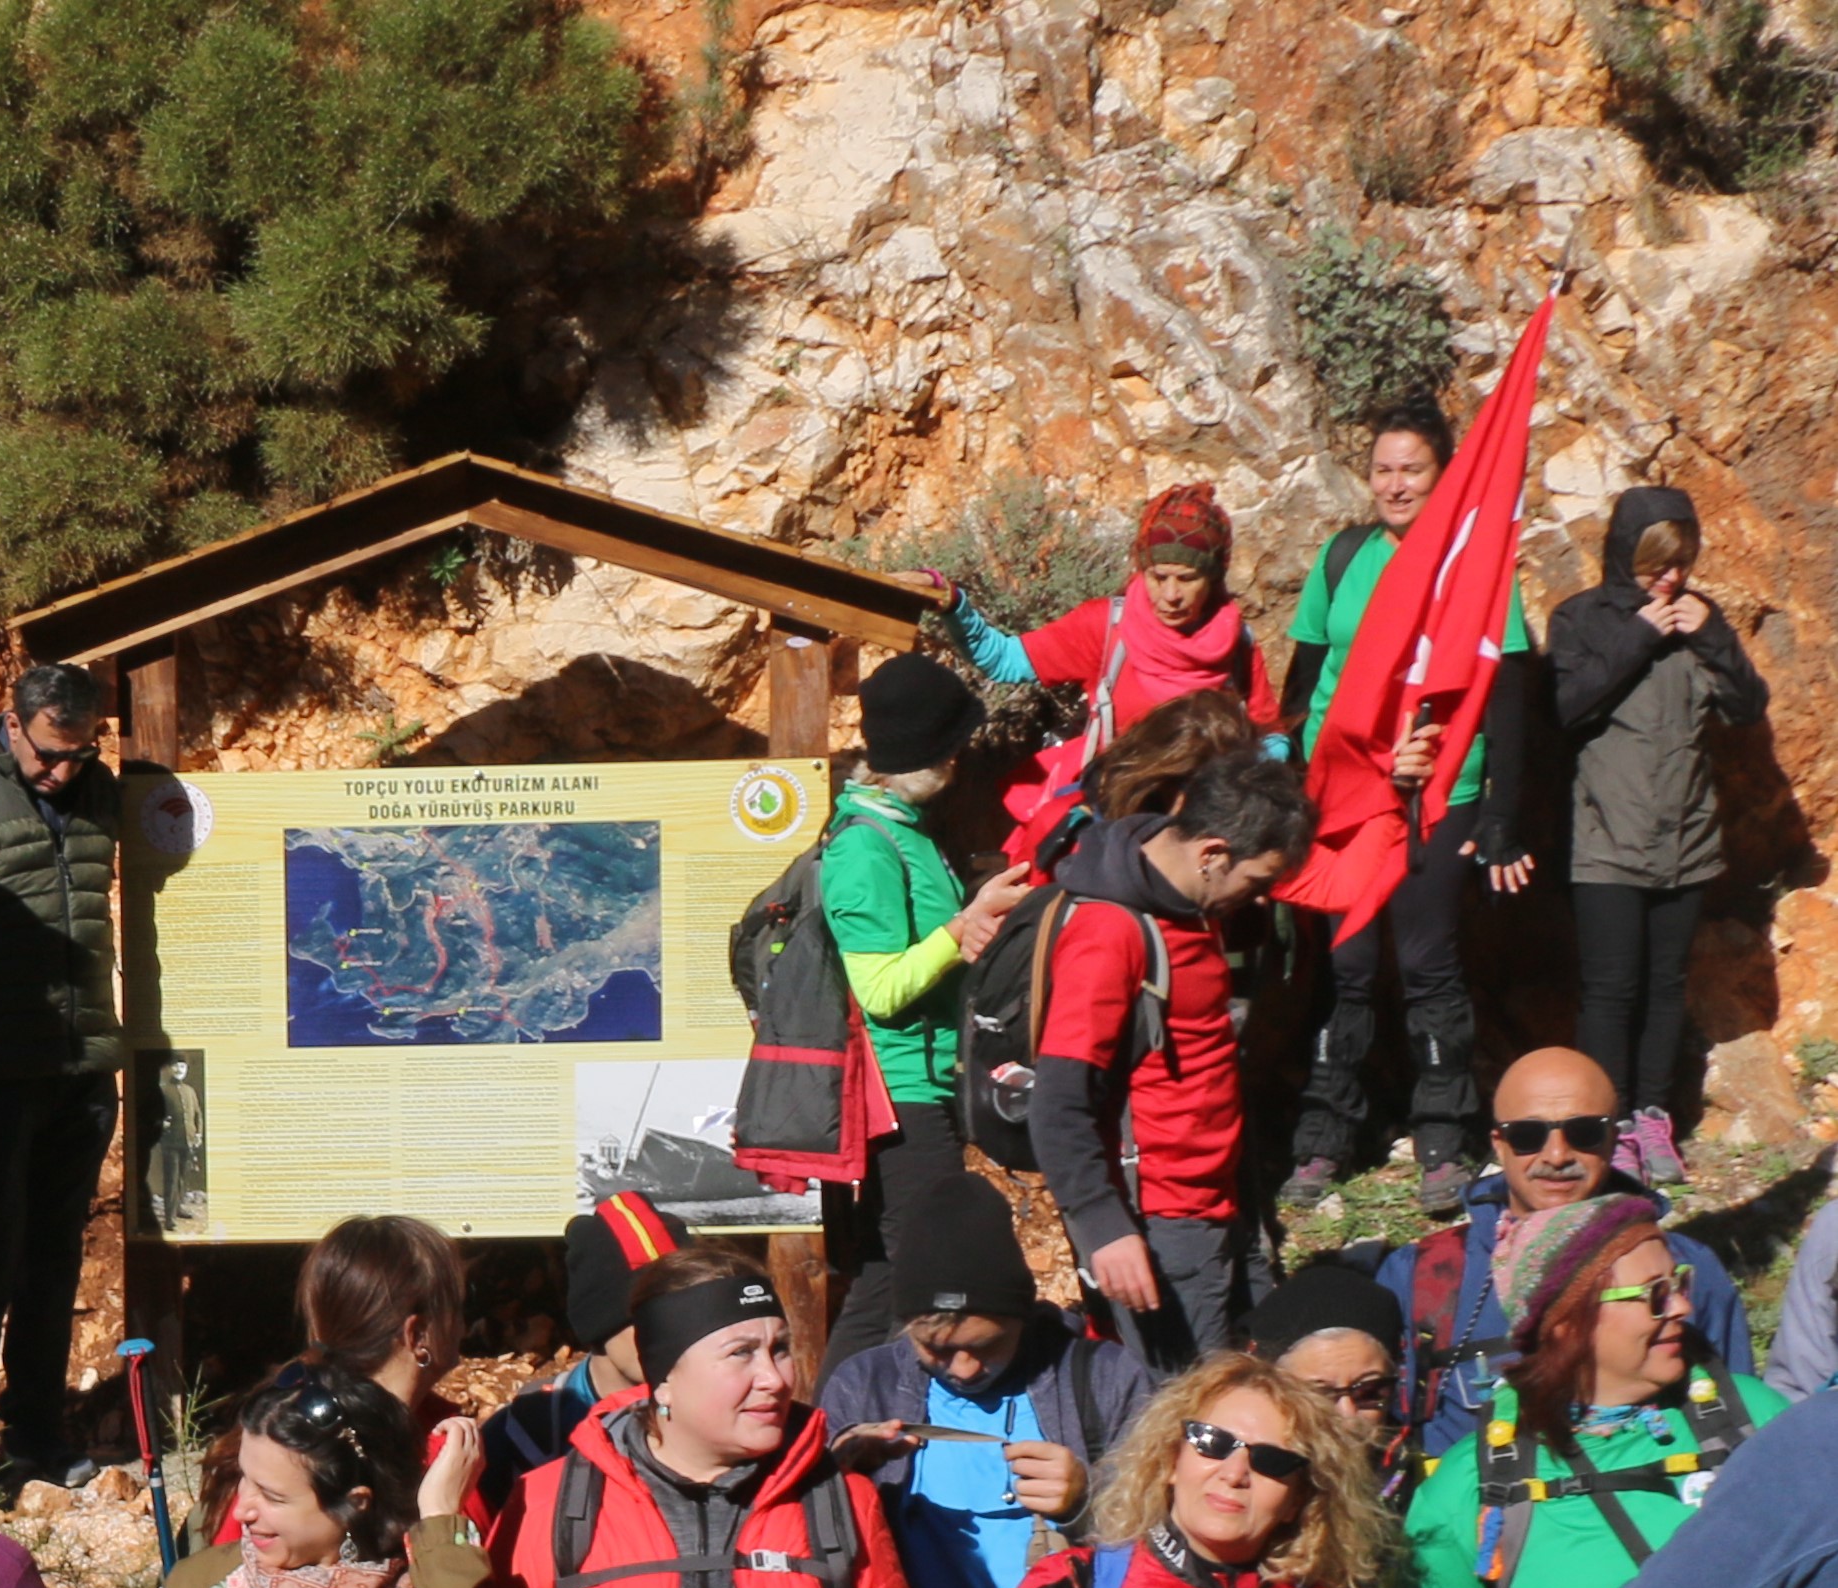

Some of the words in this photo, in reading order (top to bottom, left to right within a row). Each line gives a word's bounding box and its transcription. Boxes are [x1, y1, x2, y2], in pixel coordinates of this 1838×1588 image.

[344, 780, 398, 798] TOPÇU
[405, 778, 444, 795] YOLU
[451, 774, 545, 794] EKOTURİZM
[551, 775, 600, 791] ALANI
[369, 801, 412, 819] DOĞA
[418, 799, 494, 820] YÜRÜYÜŞ
[499, 800, 576, 817] PARKURU
